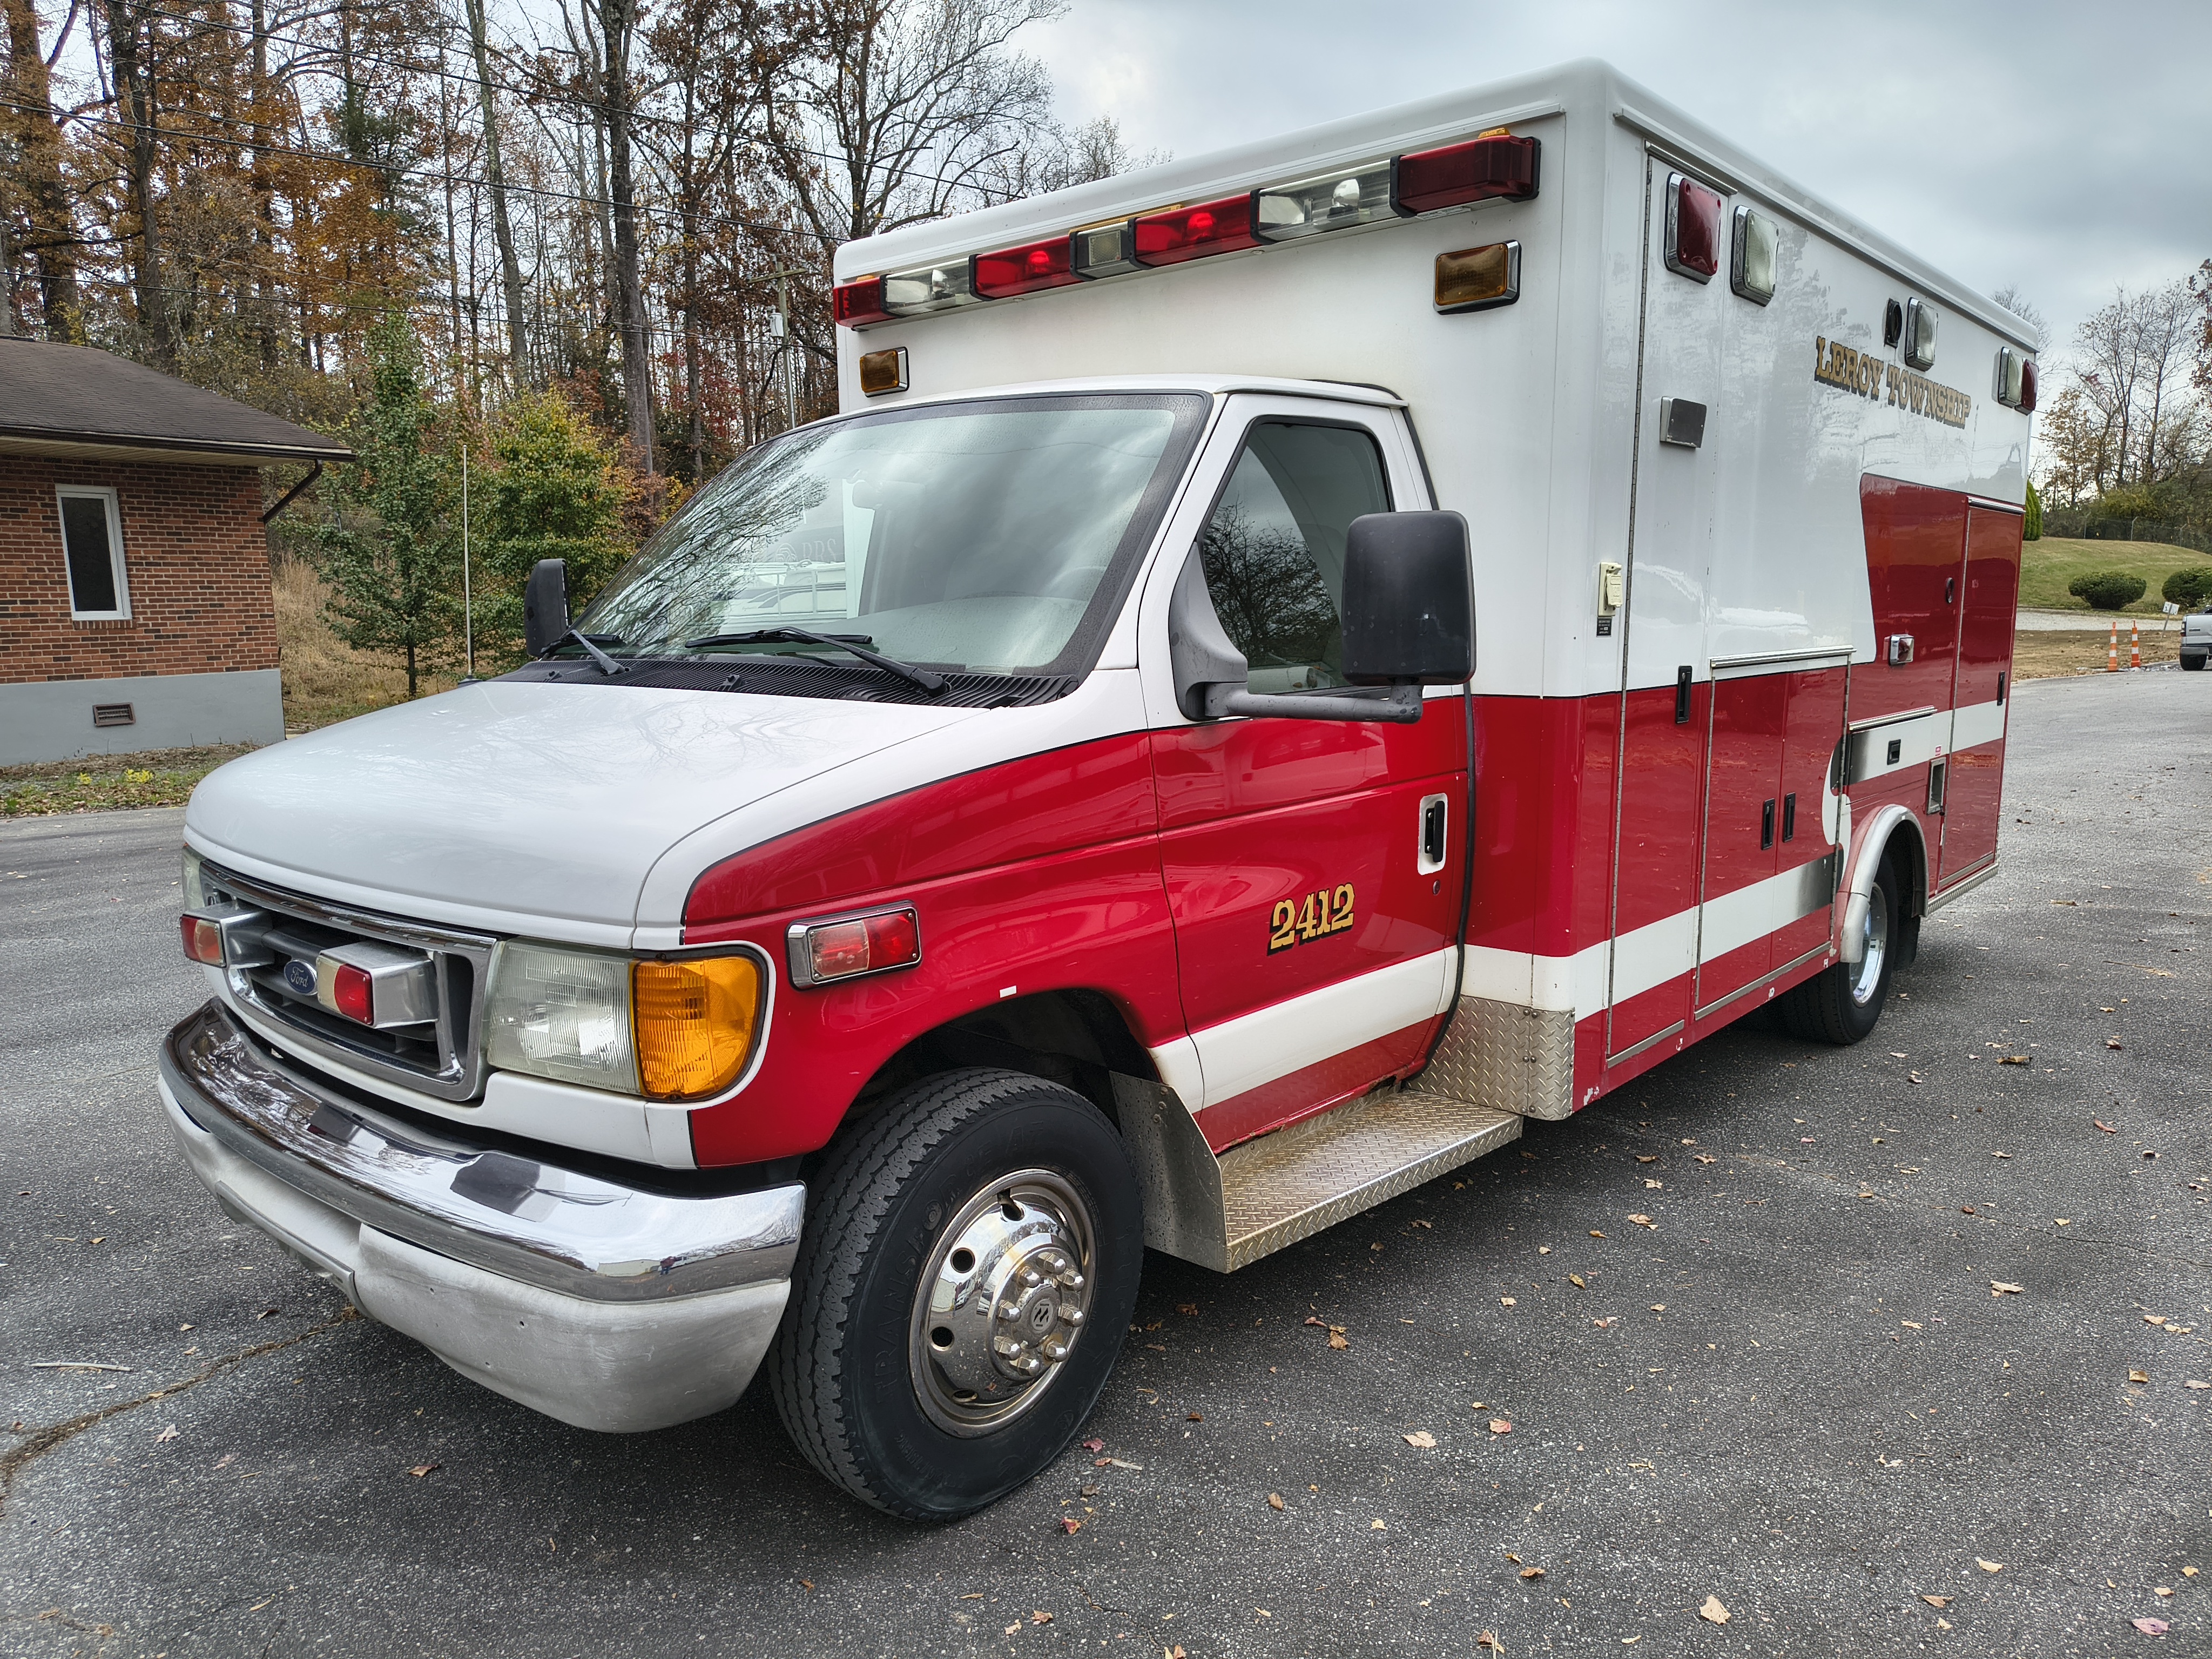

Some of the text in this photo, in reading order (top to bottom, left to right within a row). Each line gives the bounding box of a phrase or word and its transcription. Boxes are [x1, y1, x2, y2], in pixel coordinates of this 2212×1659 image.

[1814, 335, 1971, 429] LEROY TOWNSHIP
[1266, 882, 1355, 956] 2412
[290, 966, 308, 988] Ford
